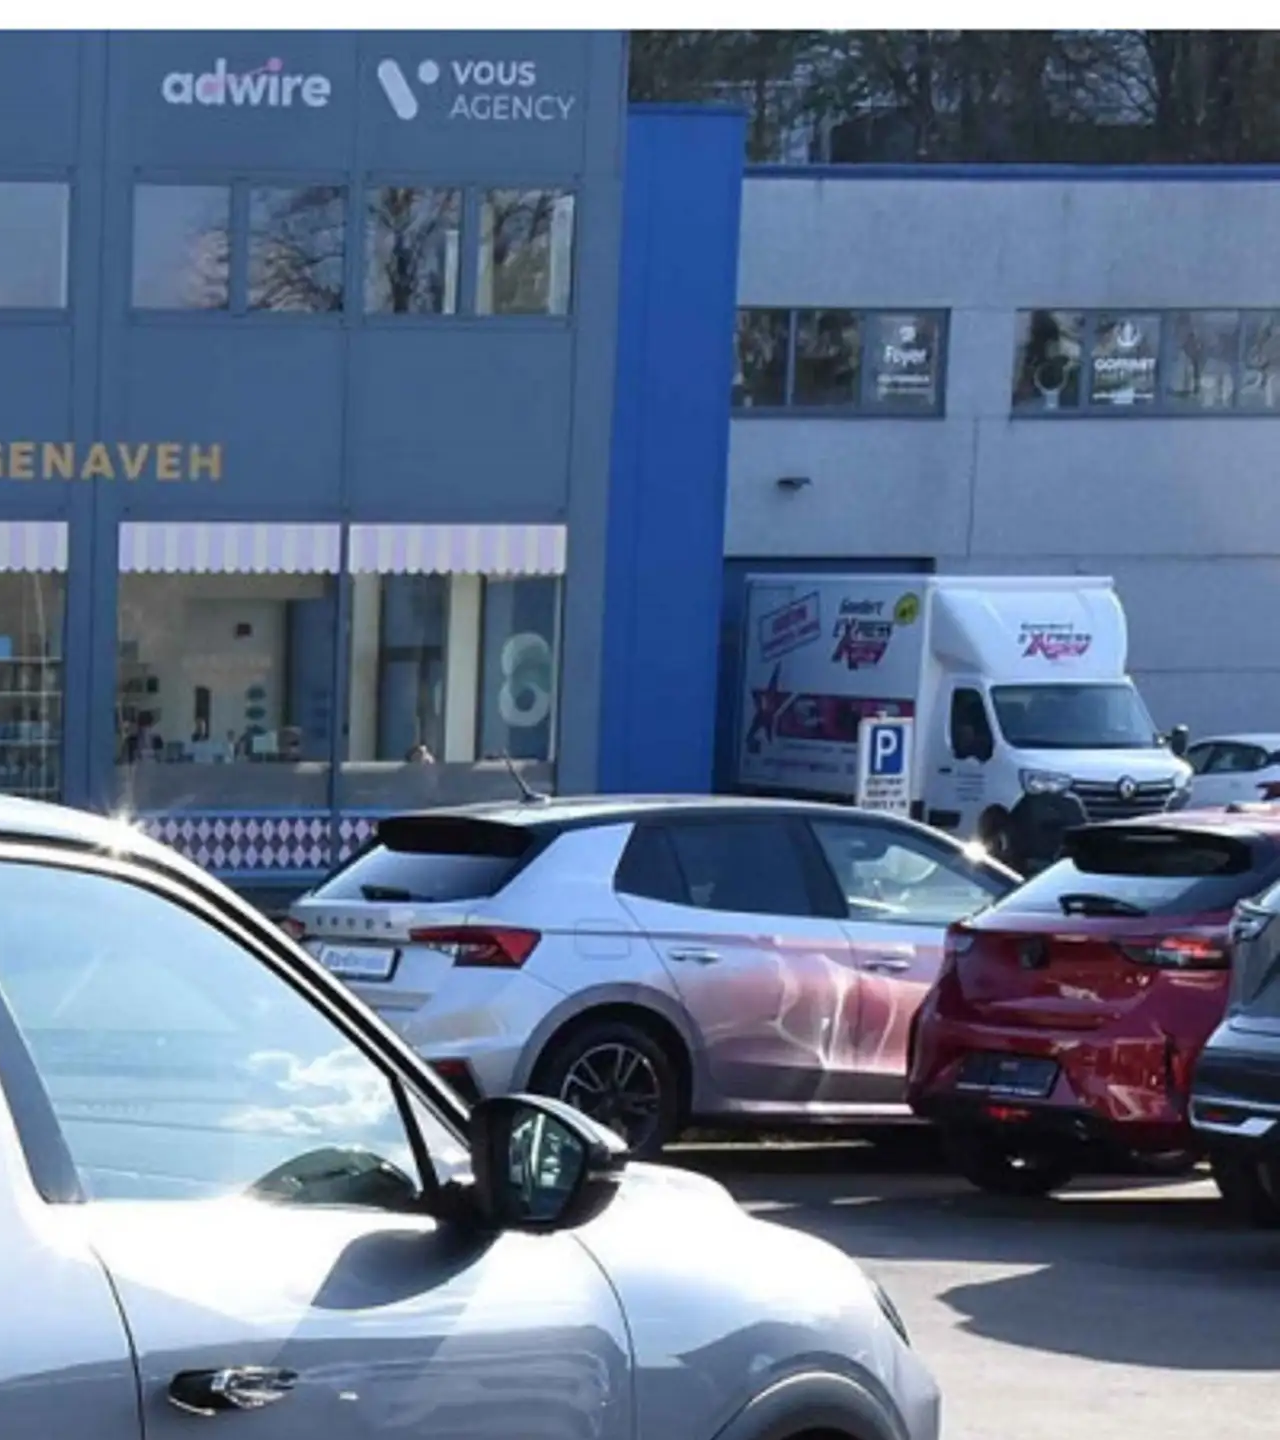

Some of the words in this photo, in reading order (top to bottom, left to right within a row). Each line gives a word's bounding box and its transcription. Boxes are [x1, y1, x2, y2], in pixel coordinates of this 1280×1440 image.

[162, 57, 332, 107] adwire
[452, 60, 536, 87] VOUS
[448, 96, 575, 121] AGENCY
[874, 729, 898, 771] P
